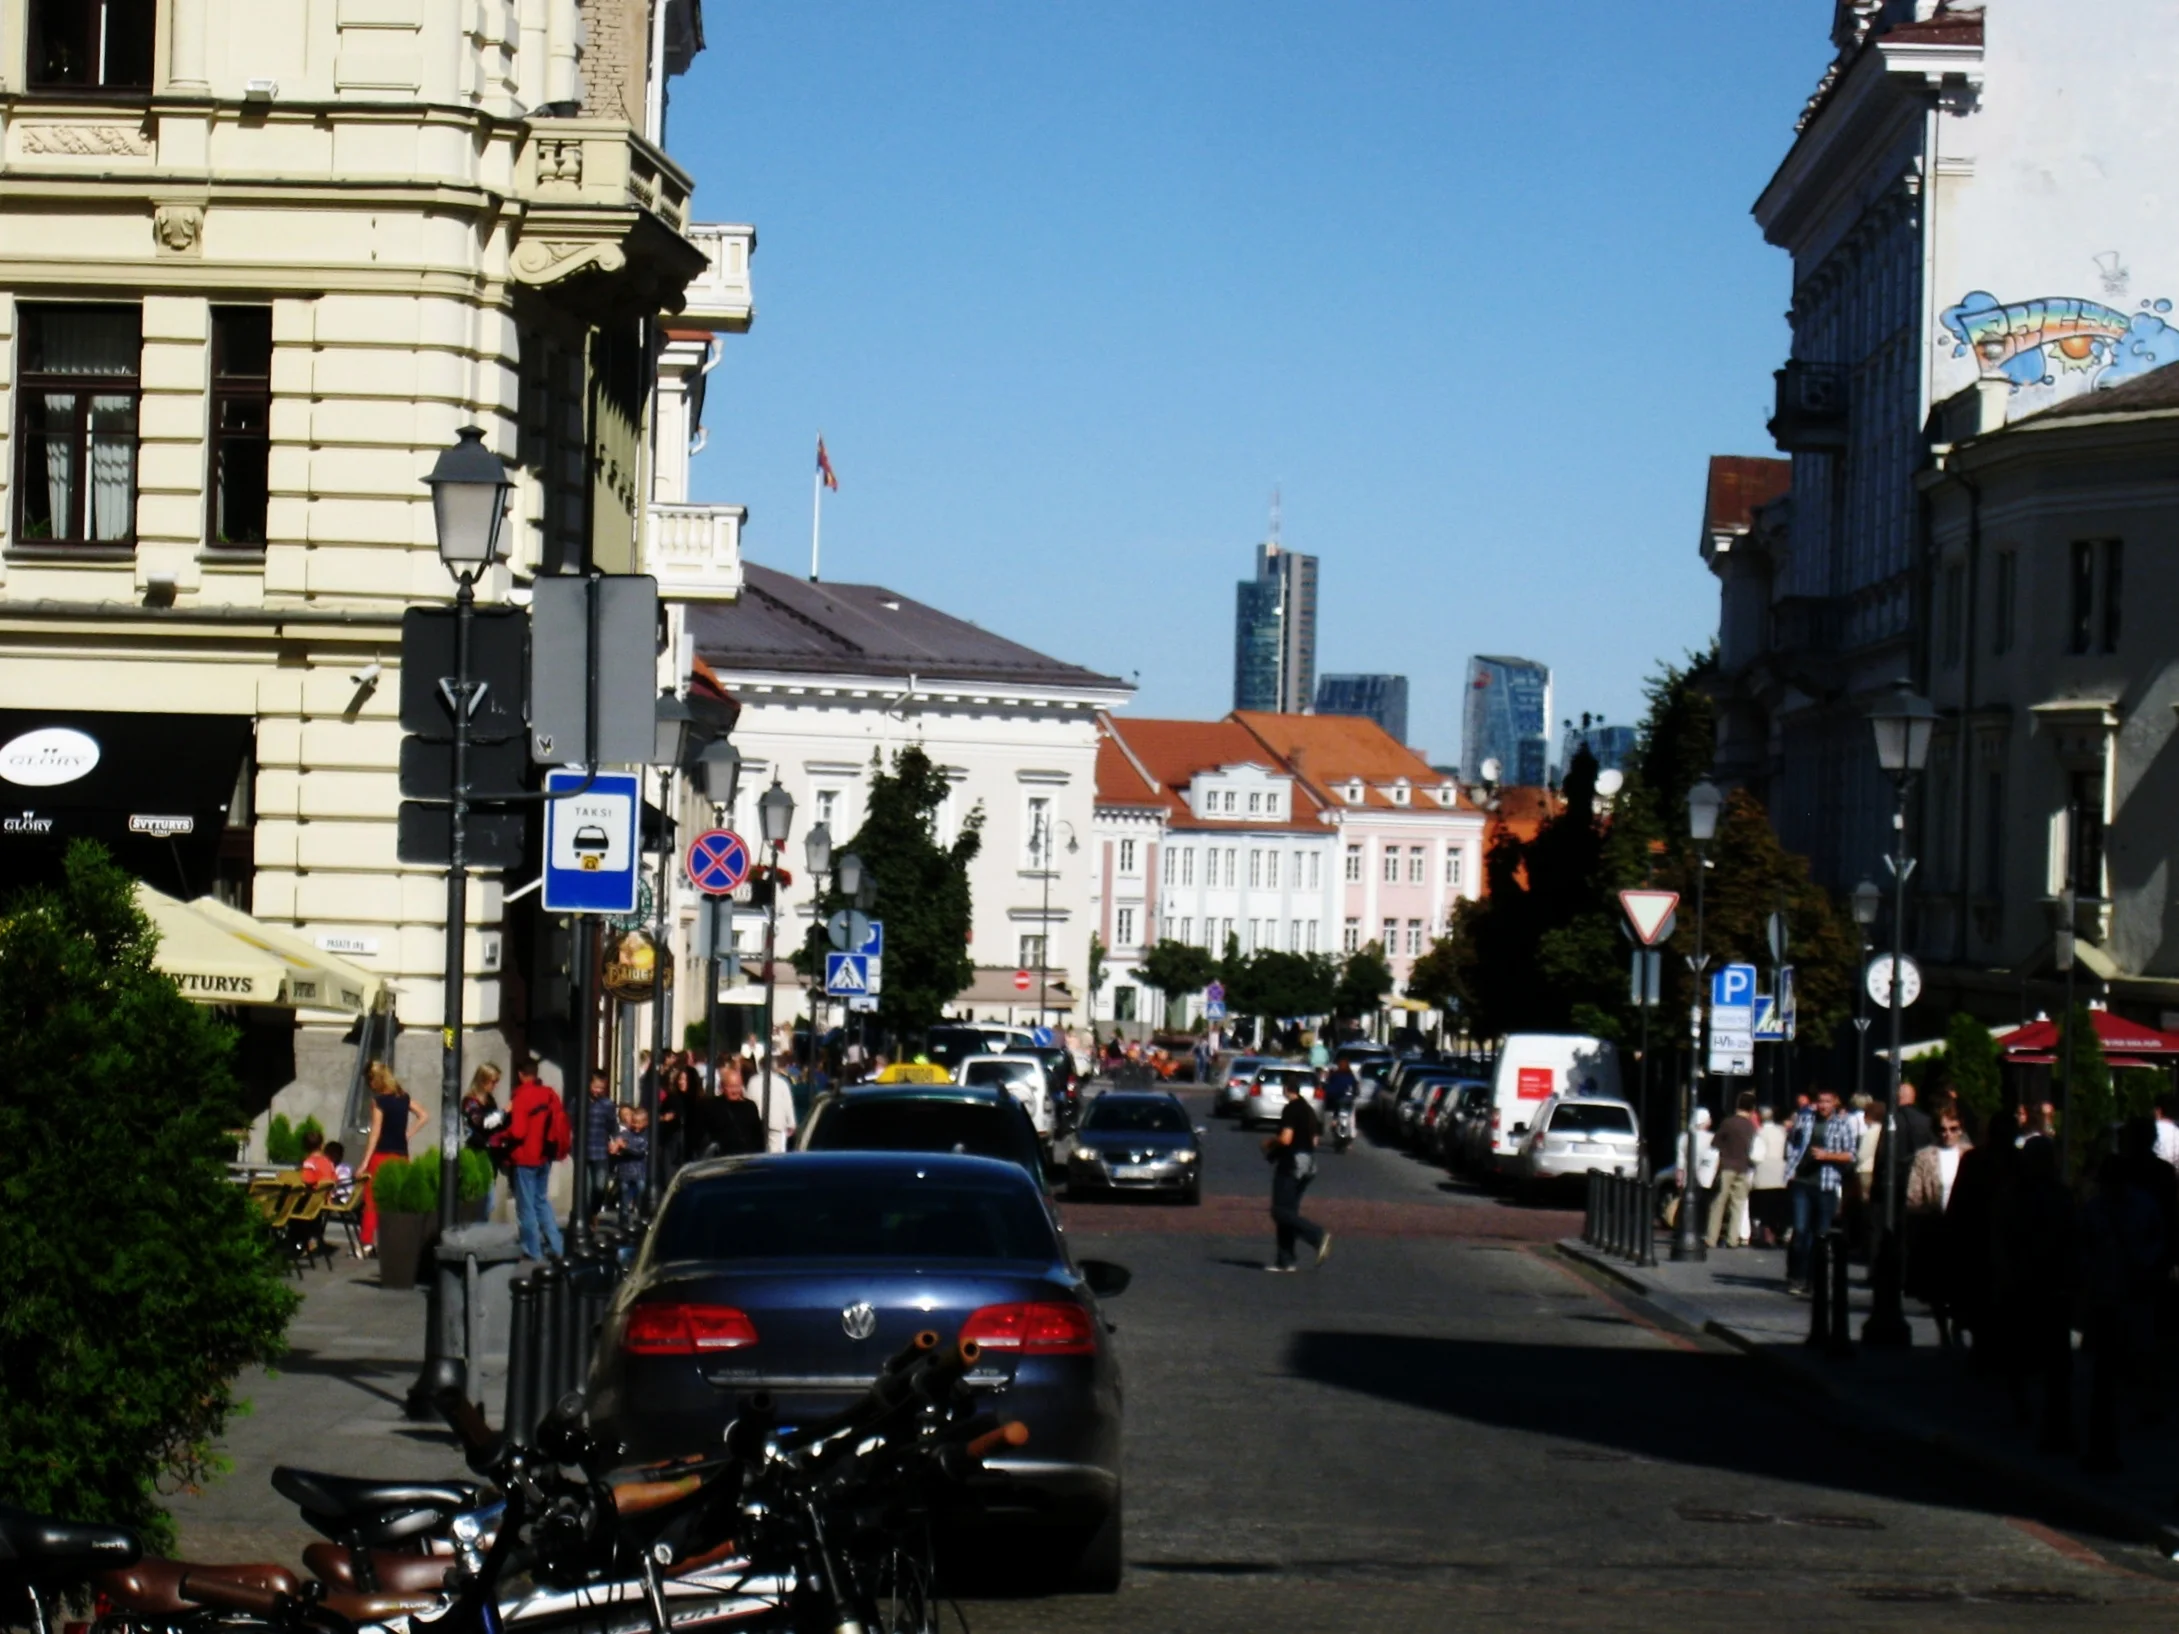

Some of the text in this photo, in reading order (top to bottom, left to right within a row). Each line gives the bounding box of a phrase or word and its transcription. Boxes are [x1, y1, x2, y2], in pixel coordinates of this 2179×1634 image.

[9, 754, 87, 767] GLORY
[574, 806, 613, 818] TAKSI
[3, 818, 53, 832] GLORY
[1723, 969, 1748, 1003] P
